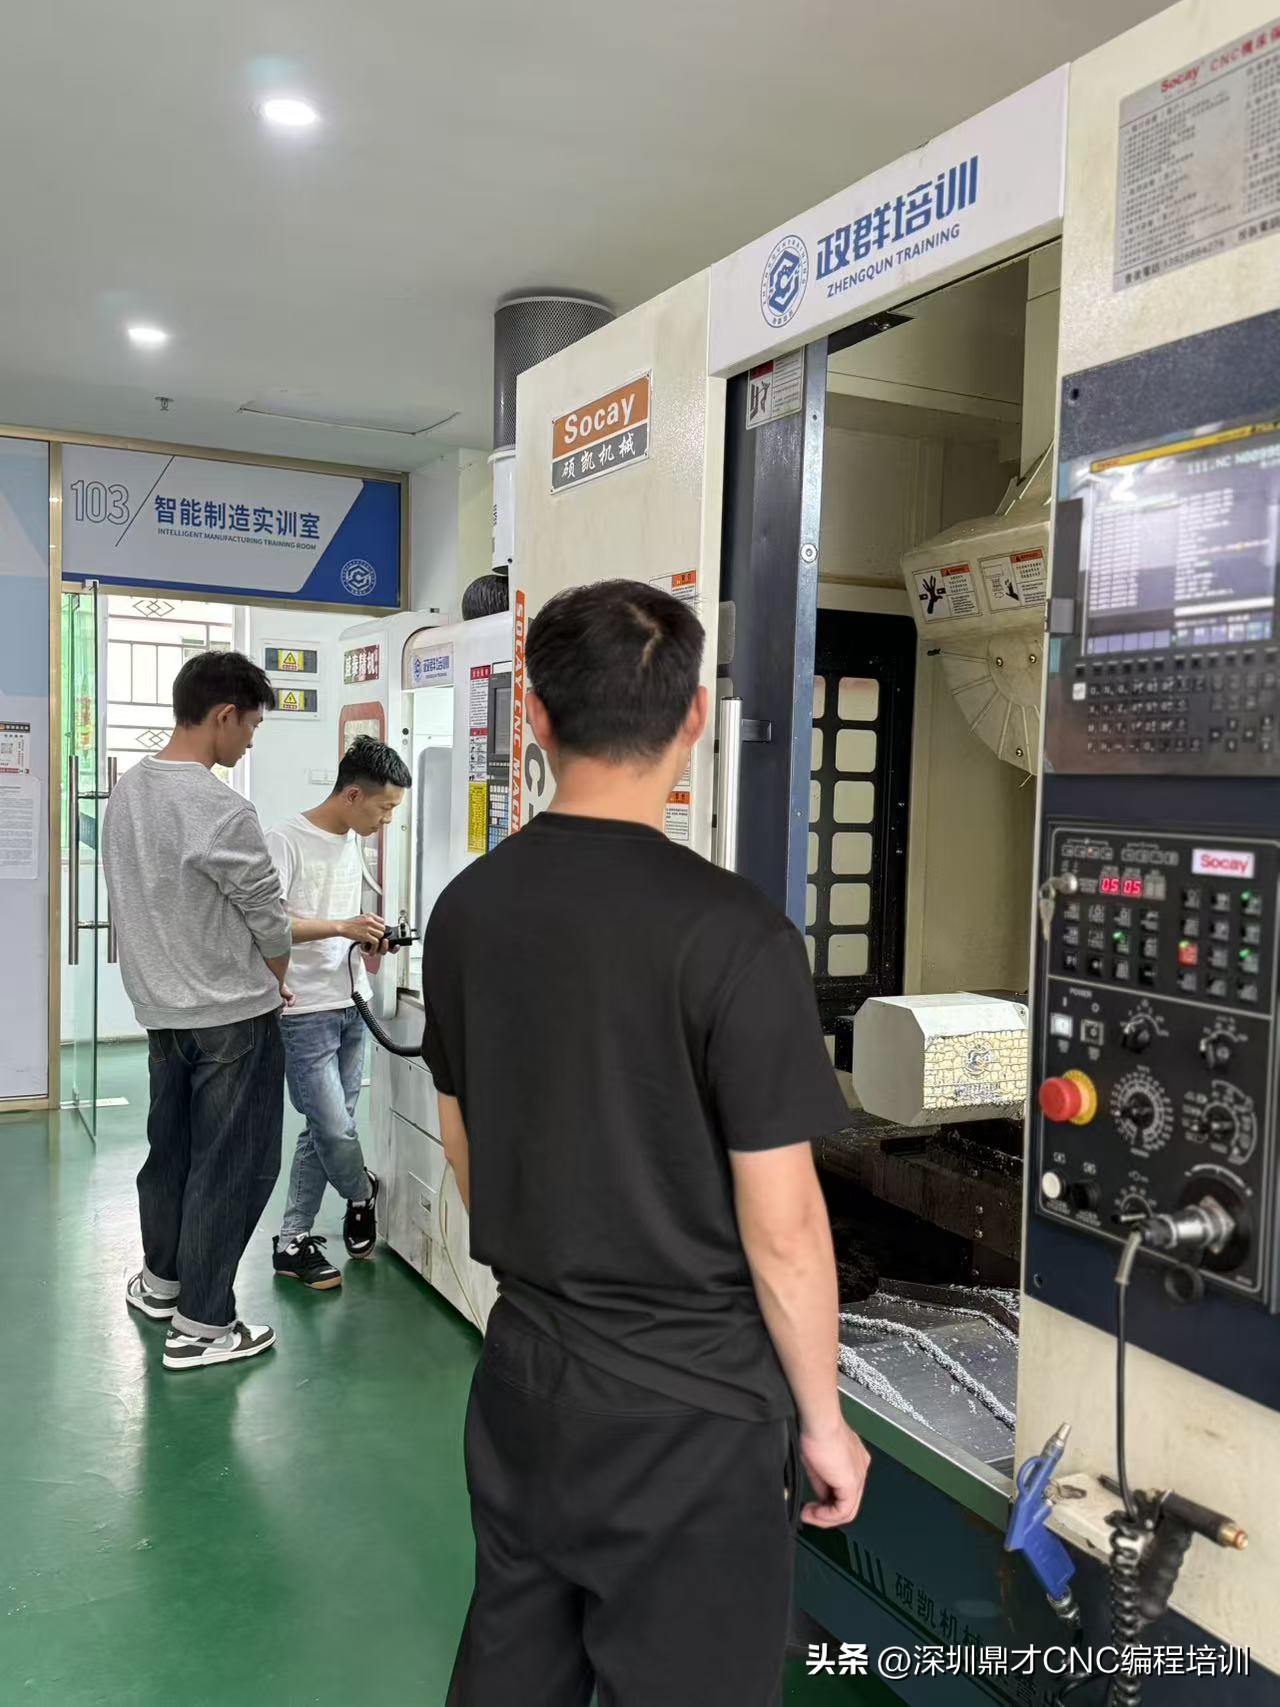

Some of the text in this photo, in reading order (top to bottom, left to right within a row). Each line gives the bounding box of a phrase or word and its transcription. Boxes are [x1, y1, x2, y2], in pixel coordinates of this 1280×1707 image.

[816, 155, 979, 281] 政群培训
[827, 223, 961, 298] ZHENGQUN TRAINING
[563, 393, 636, 444] Socay
[561, 431, 636, 479] 硕凯机械
[70, 480, 130, 526] 103
[154, 494, 321, 540] 智能制造实训室
[158, 528, 317, 550] INTELLIGENT MANUFACTURING TRAINING ROOM
[514, 602, 525, 687] SOCAY
[512, 702, 522, 749] CNC
[1101, 877, 1142, 896] 05 05
[1200, 853, 1249, 874] Socay
